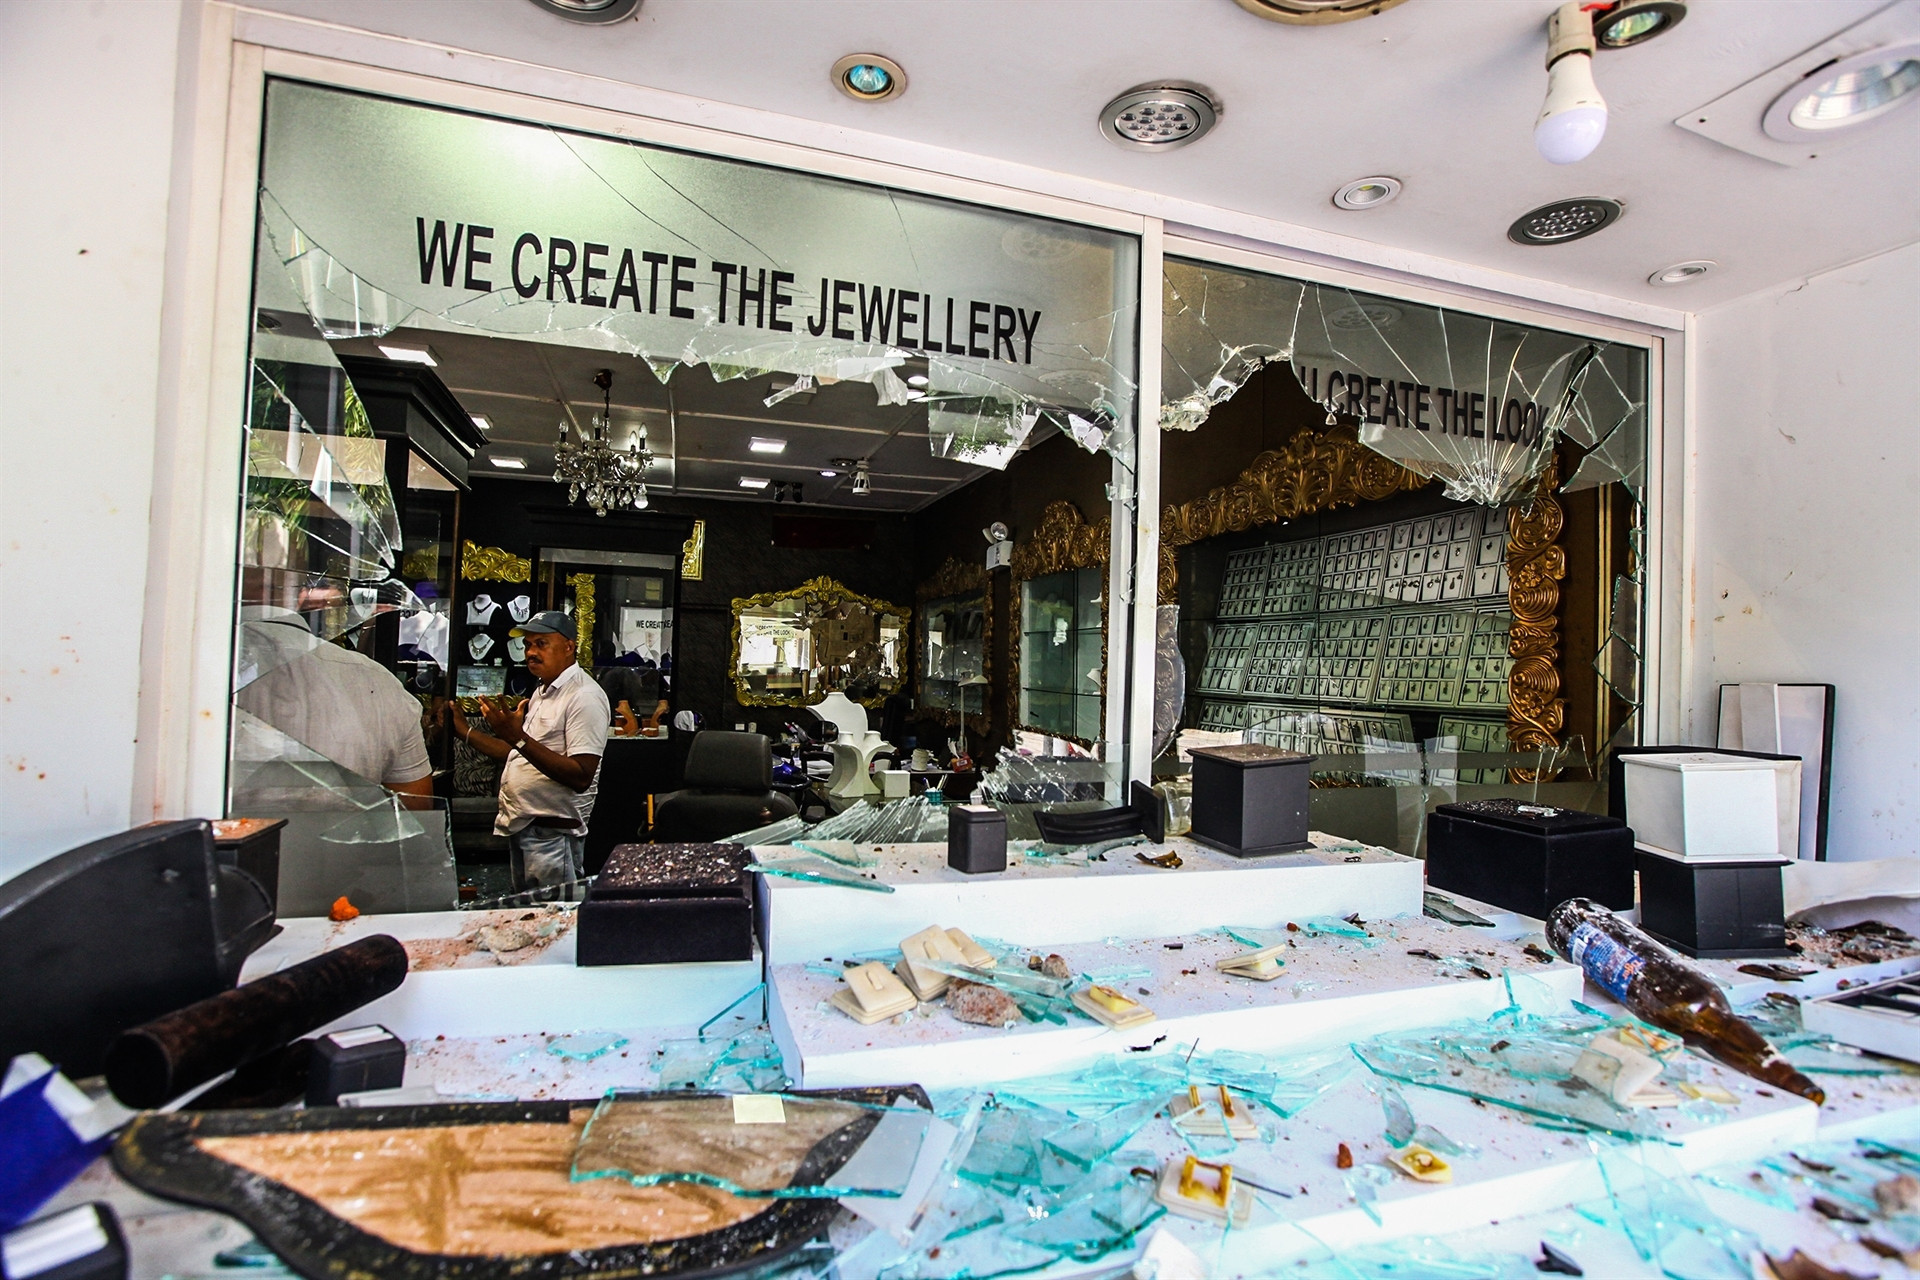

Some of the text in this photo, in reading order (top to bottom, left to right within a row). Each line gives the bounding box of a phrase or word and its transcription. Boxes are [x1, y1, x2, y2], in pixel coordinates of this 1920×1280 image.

[417, 217, 1041, 364] WE CREATE THE JEWELLERY
[1328, 371, 1430, 431] CREATE
[1438, 387, 1484, 438] THE
[1493, 397, 1550, 451] LOOK
[636, 620, 644, 628] WE
